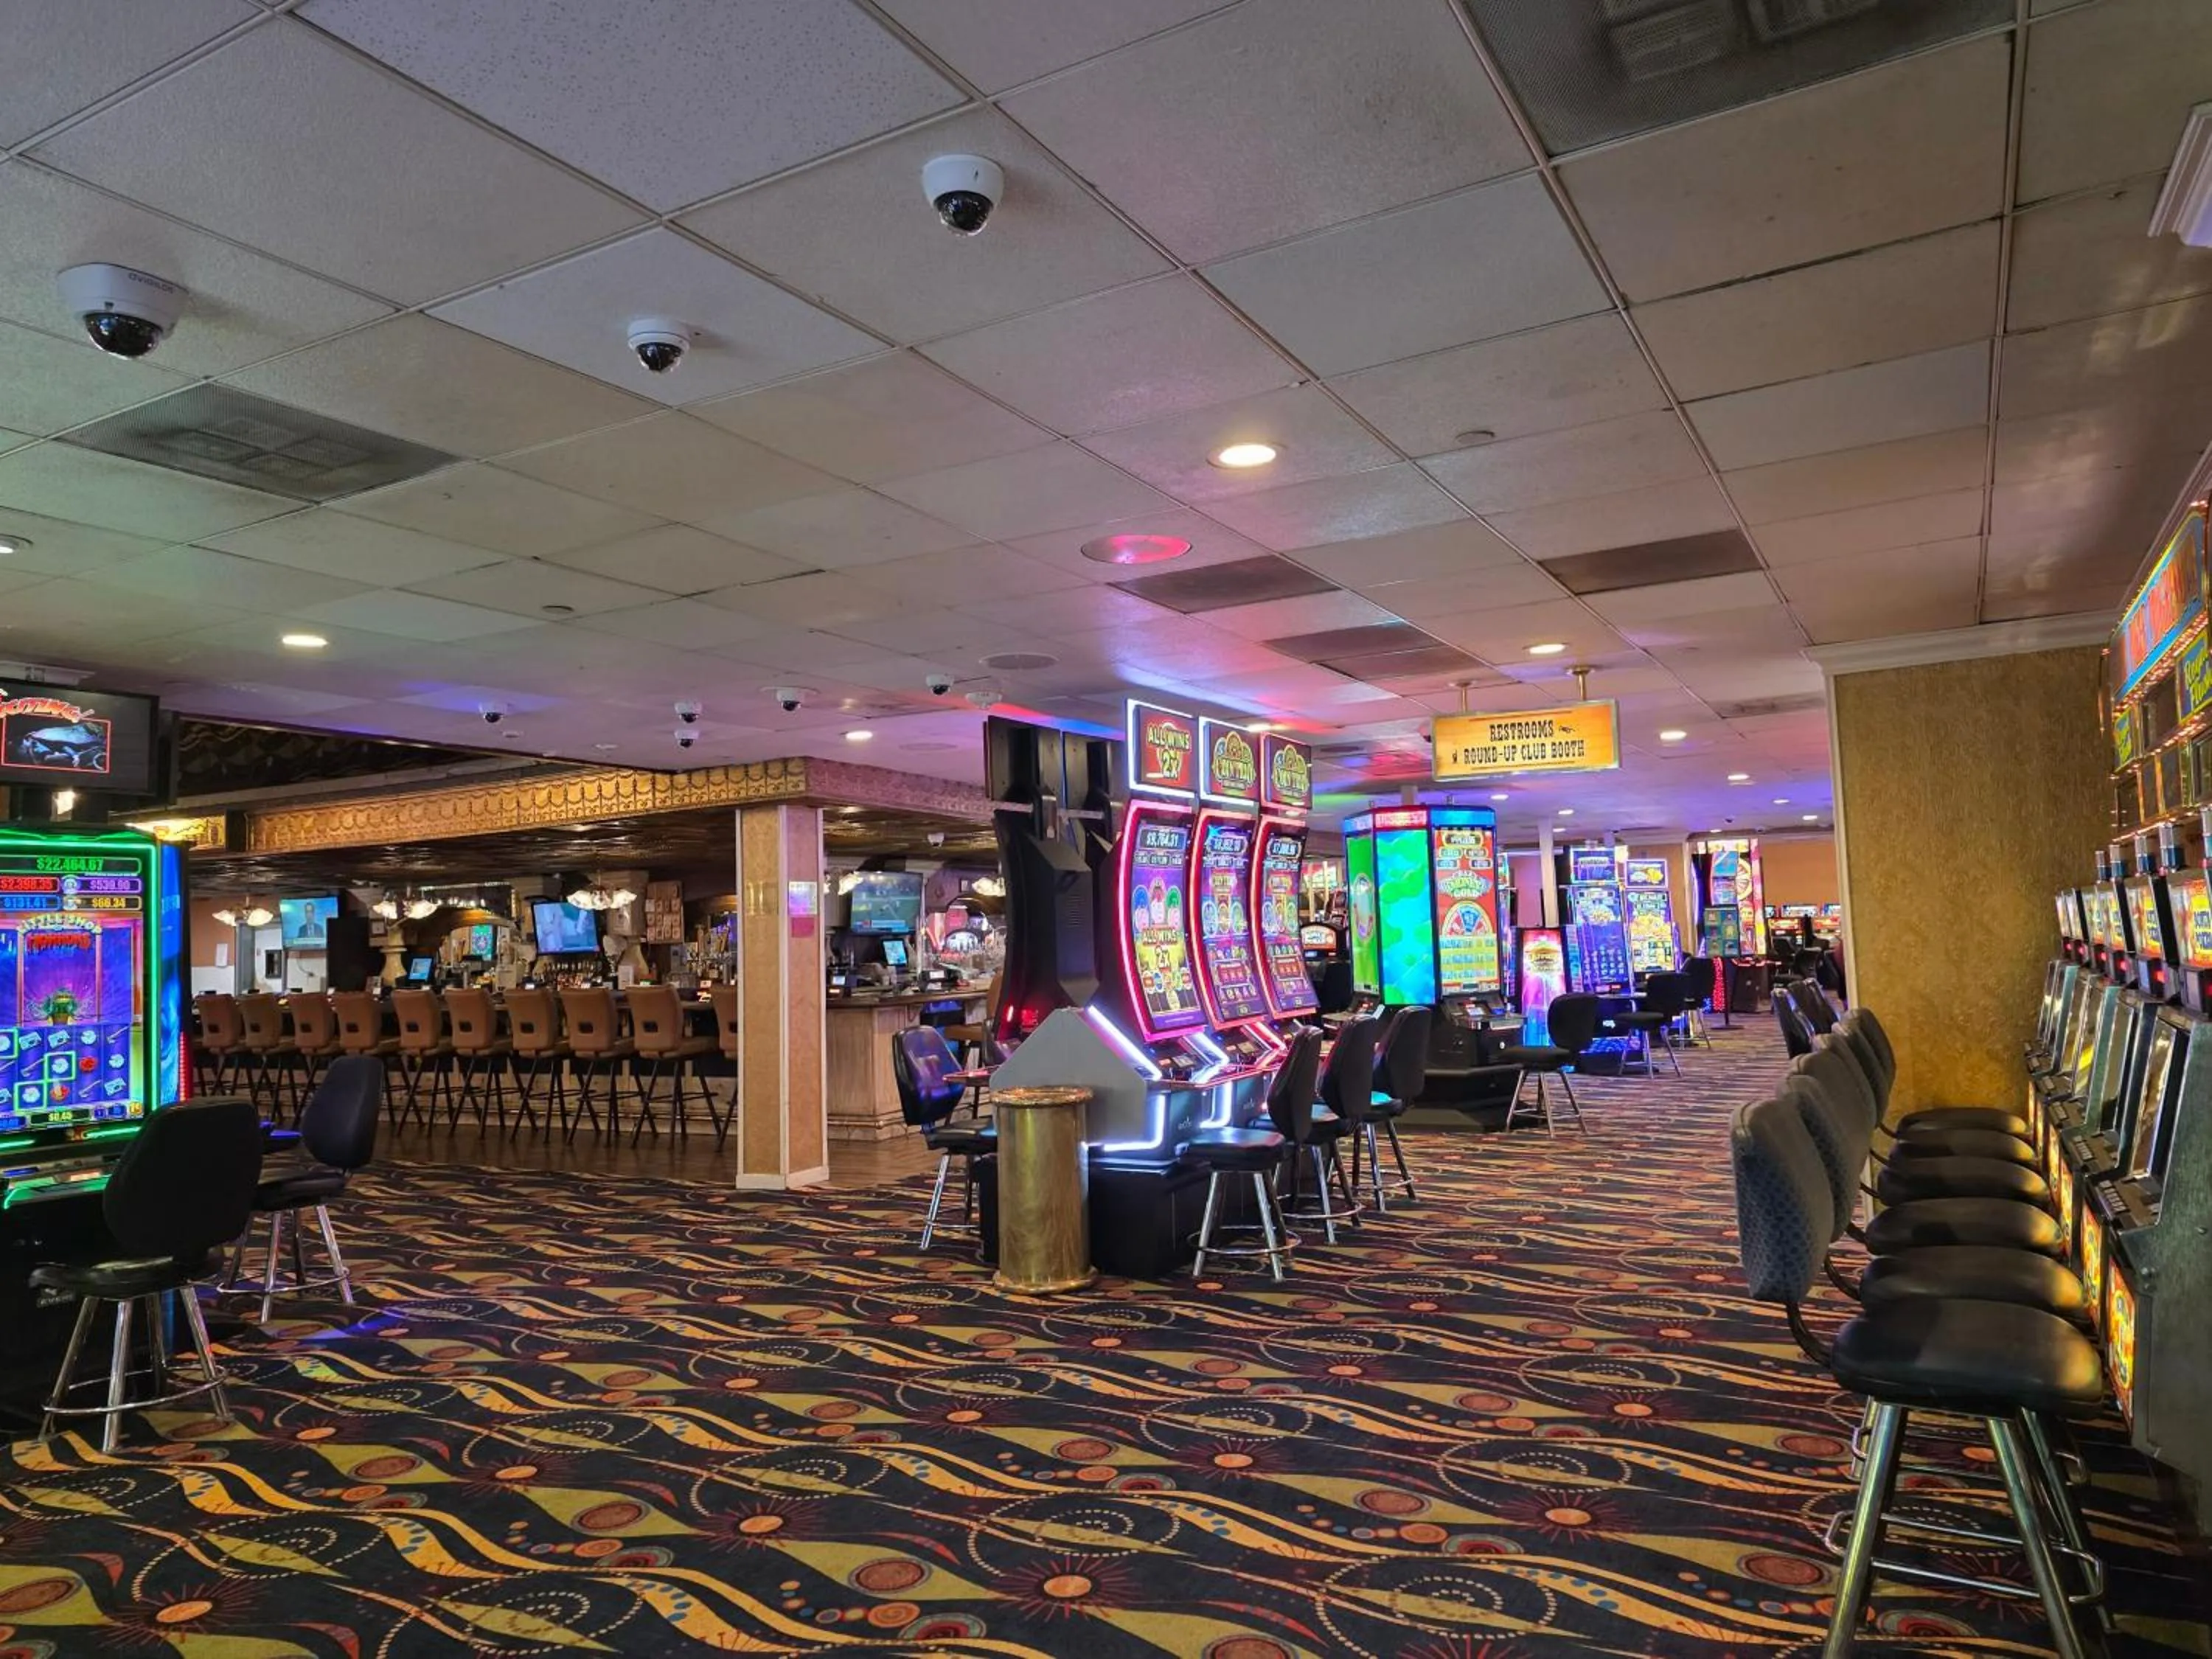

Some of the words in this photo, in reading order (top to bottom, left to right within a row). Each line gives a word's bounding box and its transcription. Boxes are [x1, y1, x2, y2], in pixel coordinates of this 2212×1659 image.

[1489, 720, 1554, 742] RESTROOMS
[1464, 745, 1517, 765] ROUND-UP
[1520, 742, 1546, 760] CLUB
[1551, 740, 1585, 758] BOOTH
